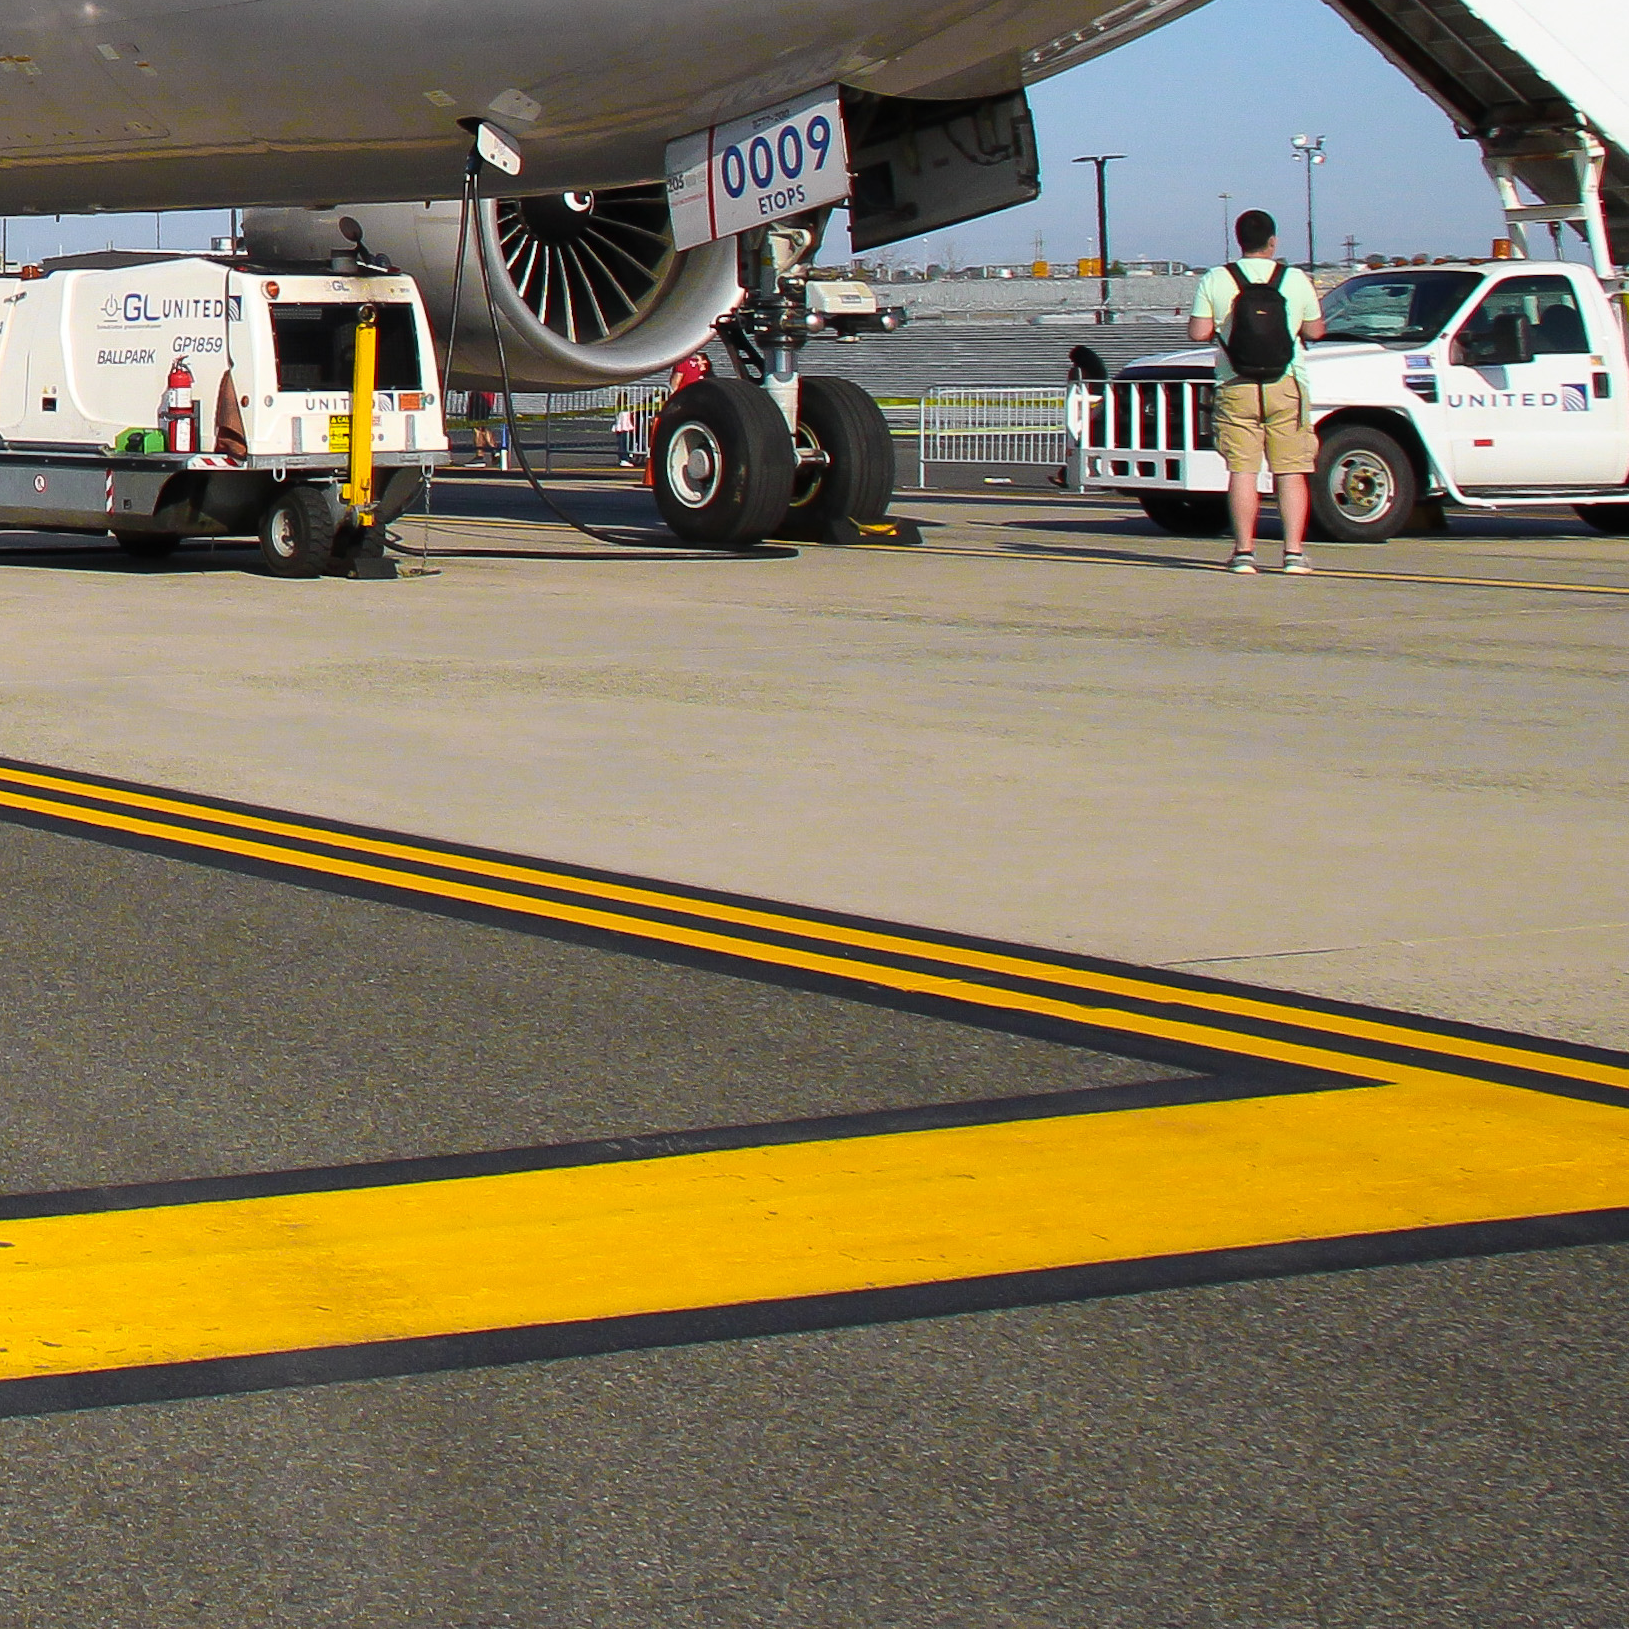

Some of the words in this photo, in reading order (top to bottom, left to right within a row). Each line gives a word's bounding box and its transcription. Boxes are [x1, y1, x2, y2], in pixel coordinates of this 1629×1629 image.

[721, 115, 832, 199] 0009
[758, 184, 806, 215] ETOPS
[123, 293, 161, 322] GL
[162, 299, 224, 319] UNITED
[172, 336, 223, 354] GP1859
[96, 349, 156, 366] BALLPARK
[1448, 393, 1558, 408] UNITED
